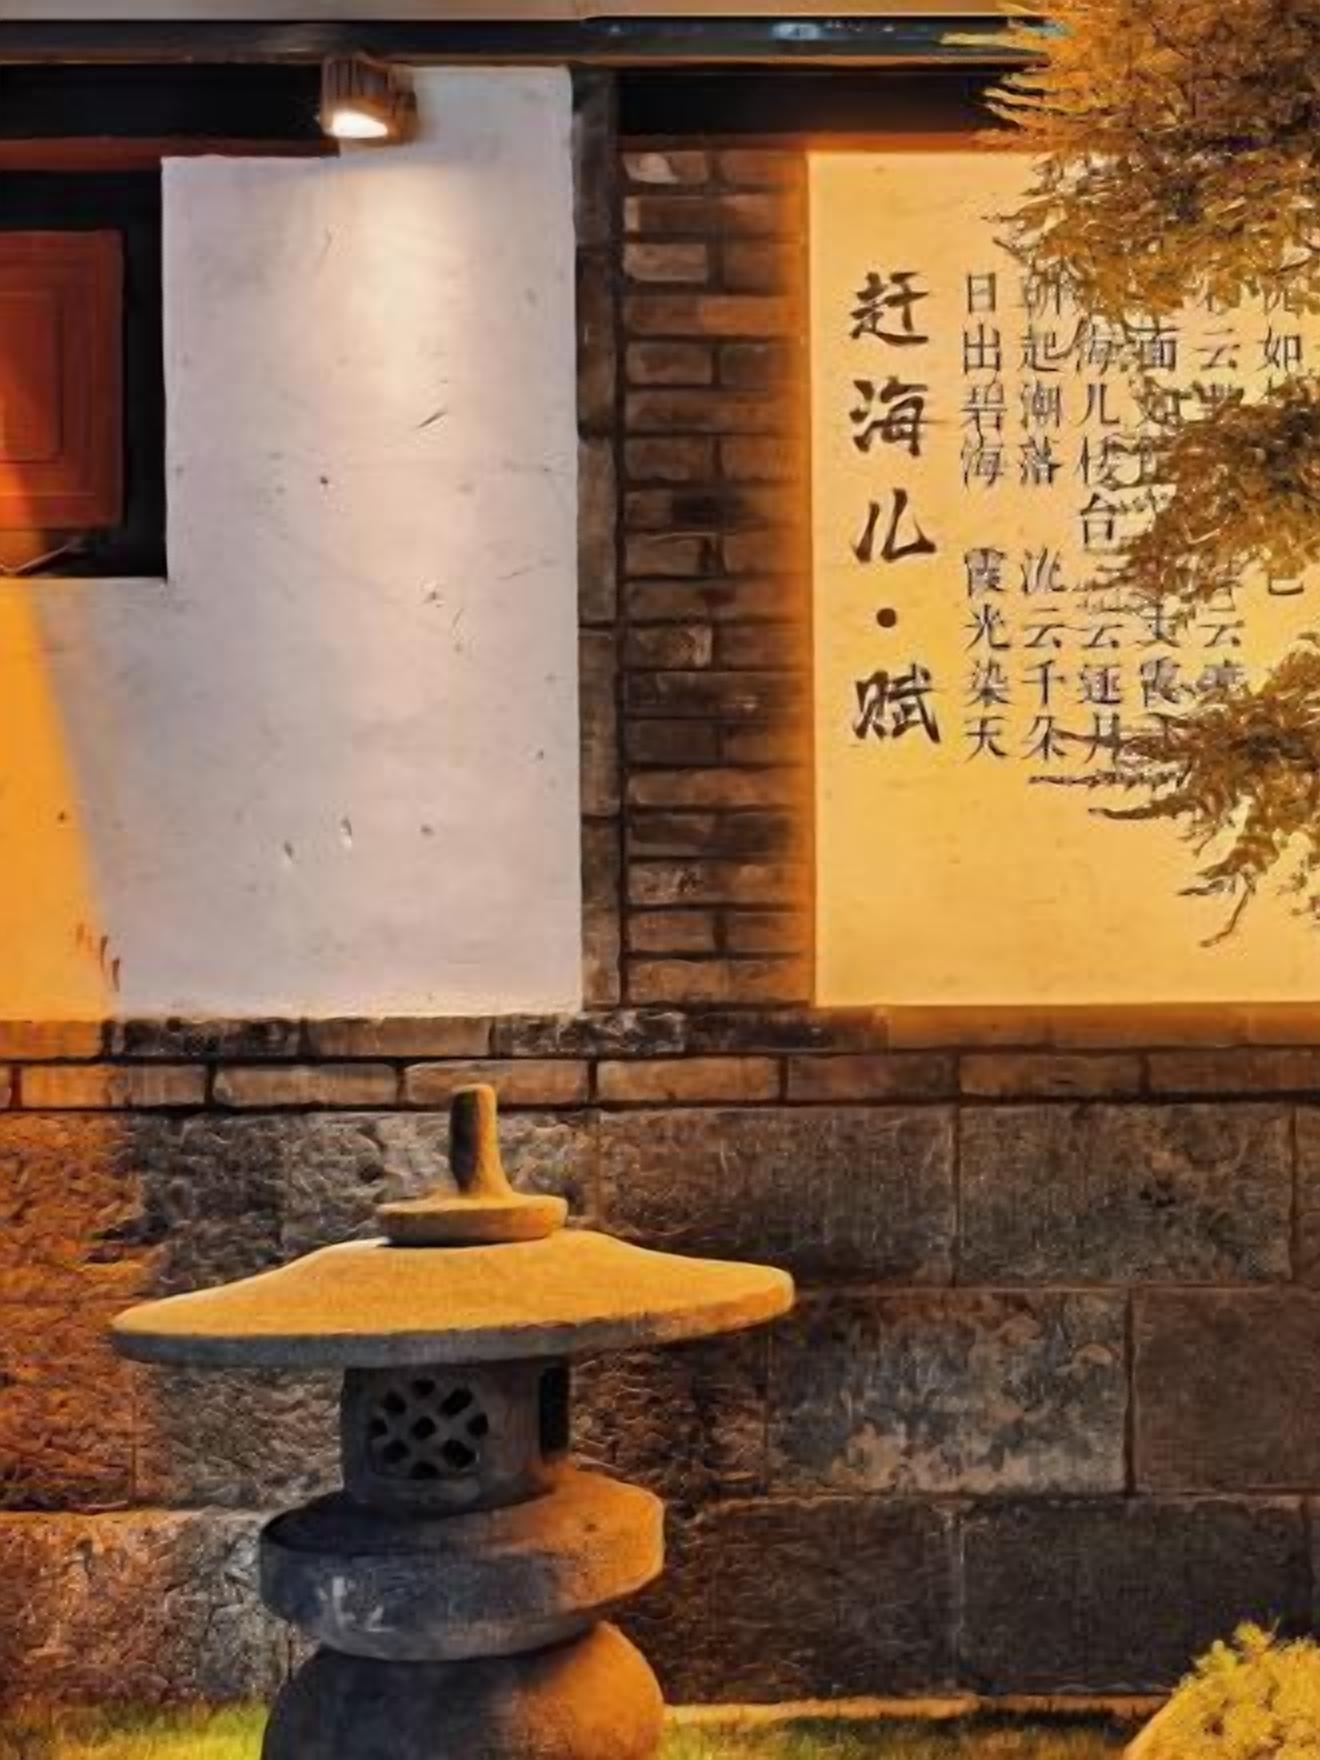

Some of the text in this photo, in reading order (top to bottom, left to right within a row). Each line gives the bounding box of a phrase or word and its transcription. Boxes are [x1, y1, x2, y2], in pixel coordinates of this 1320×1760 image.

[850, 271, 941, 743] 赶海儿·赋
[963, 547, 1010, 759] 霞光染天
[1020, 546, 1067, 761] 流云千朵
